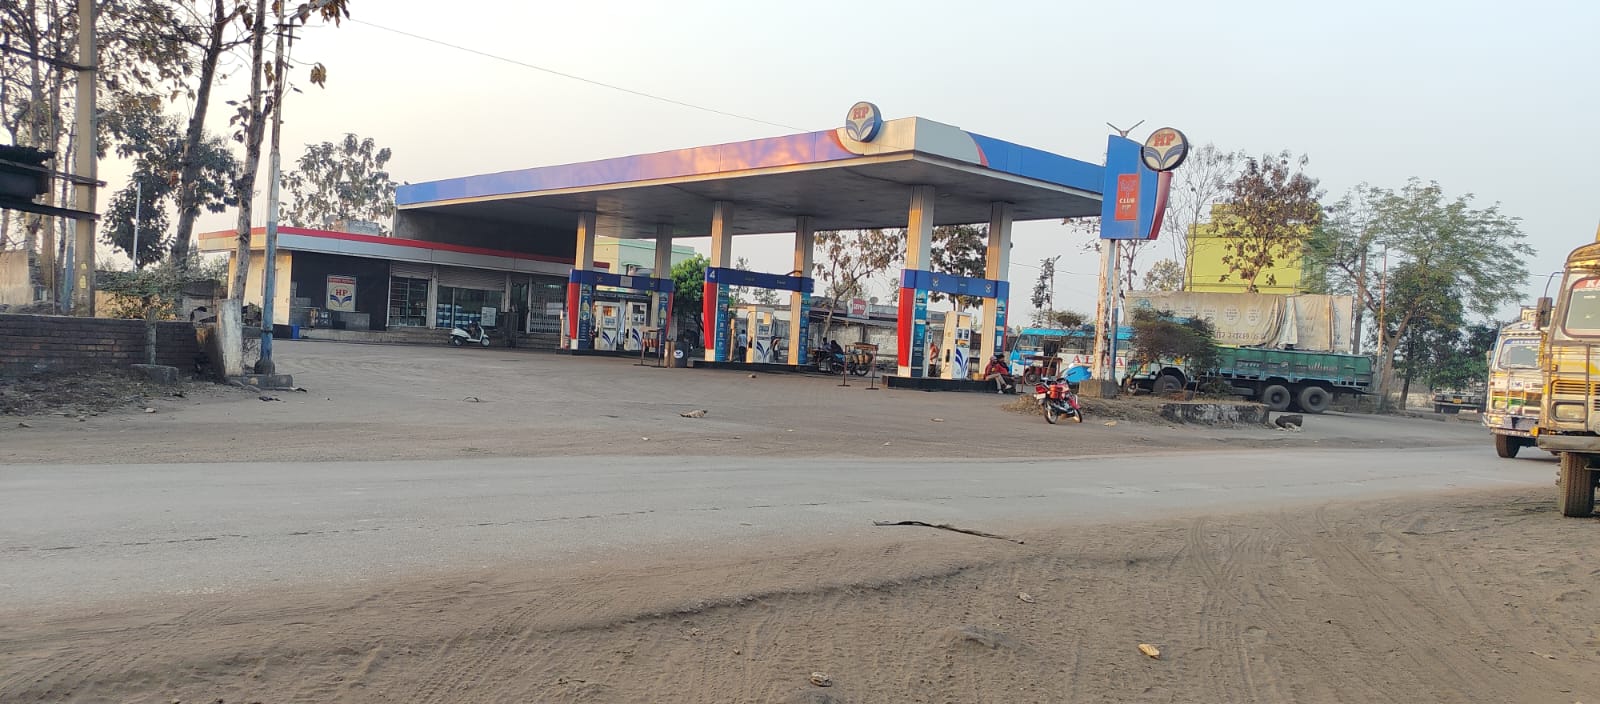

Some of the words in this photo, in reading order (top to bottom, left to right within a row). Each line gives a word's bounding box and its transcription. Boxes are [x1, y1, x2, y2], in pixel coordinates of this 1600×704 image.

[853, 106, 869, 120] HP
[1154, 133, 1175, 147] HP
[709, 270, 716, 280] 4
[336, 288, 348, 296] HP
